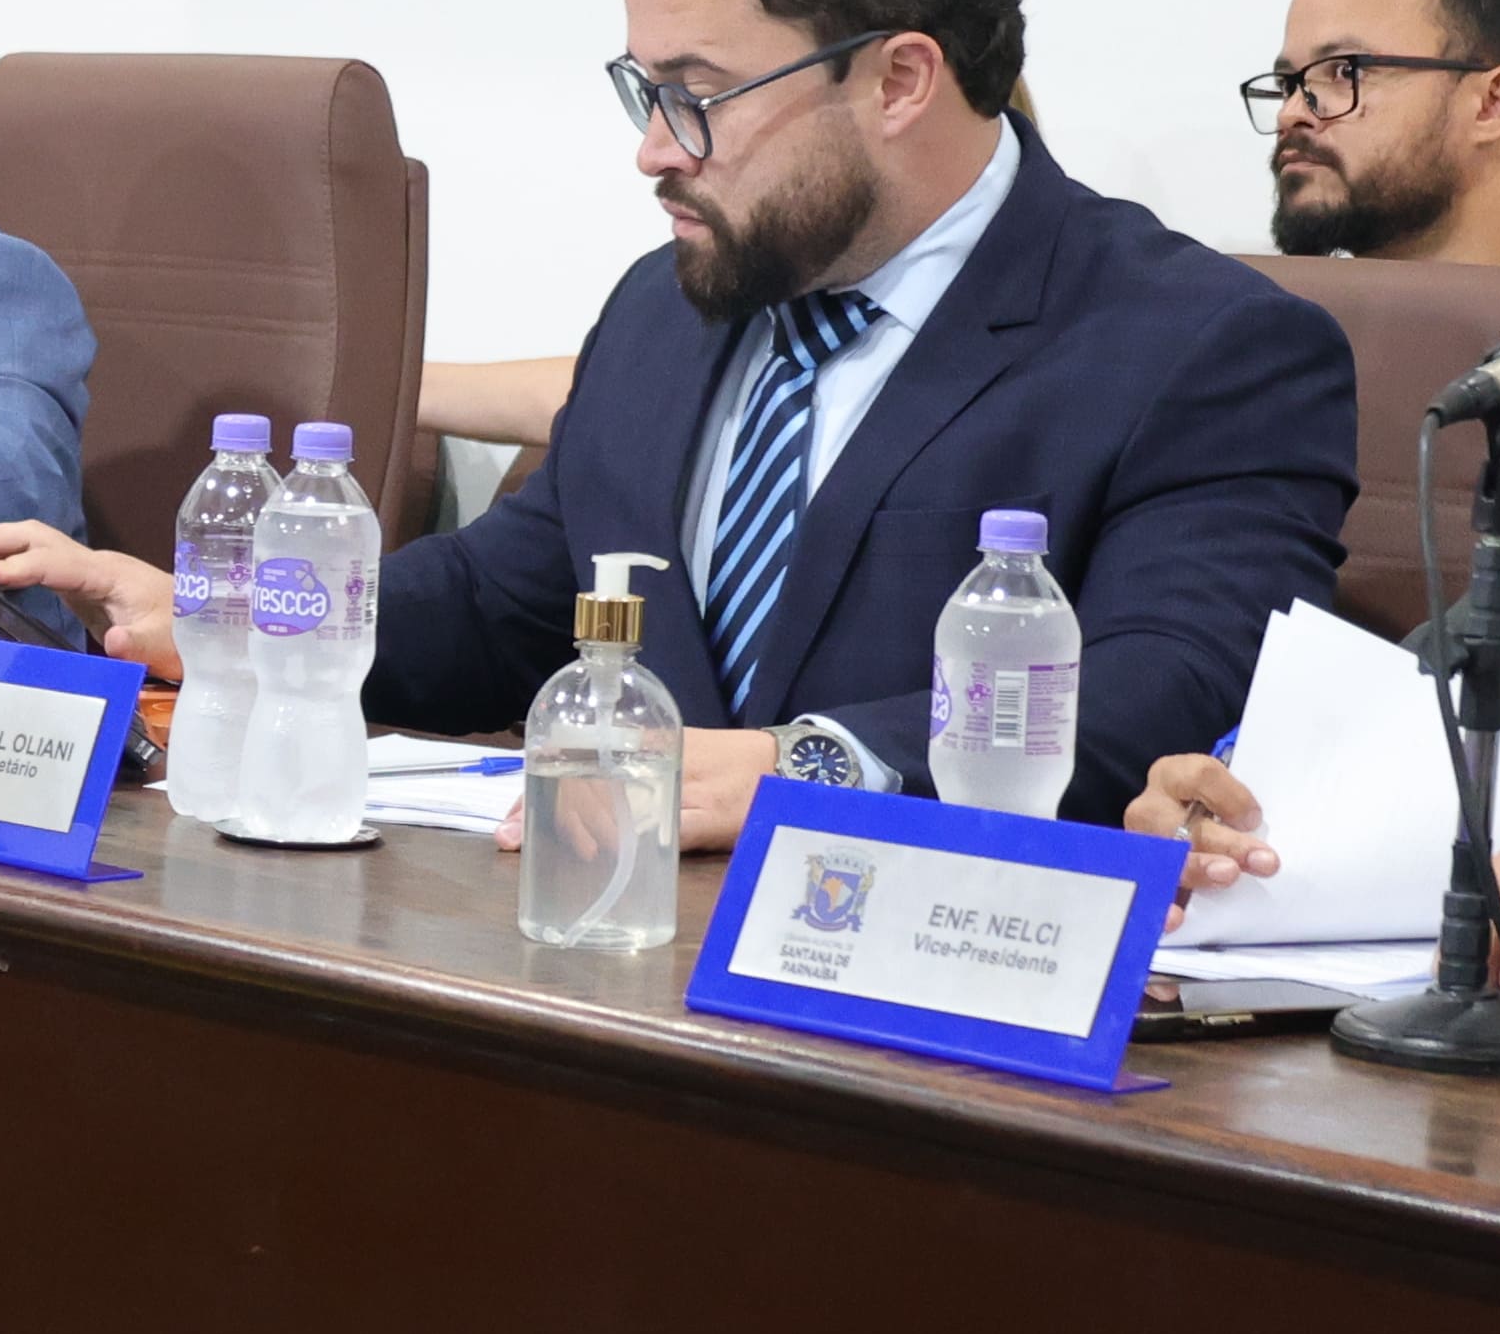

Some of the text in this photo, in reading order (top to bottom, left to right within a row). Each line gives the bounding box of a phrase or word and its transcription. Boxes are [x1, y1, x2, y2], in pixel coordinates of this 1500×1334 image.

[12, 733, 75, 762] OLIANI
[928, 904, 1062, 947] ENF. NELCI
[780, 943, 851, 967] SANTANA DE
[913, 932, 1059, 975] Vice-Presidente
